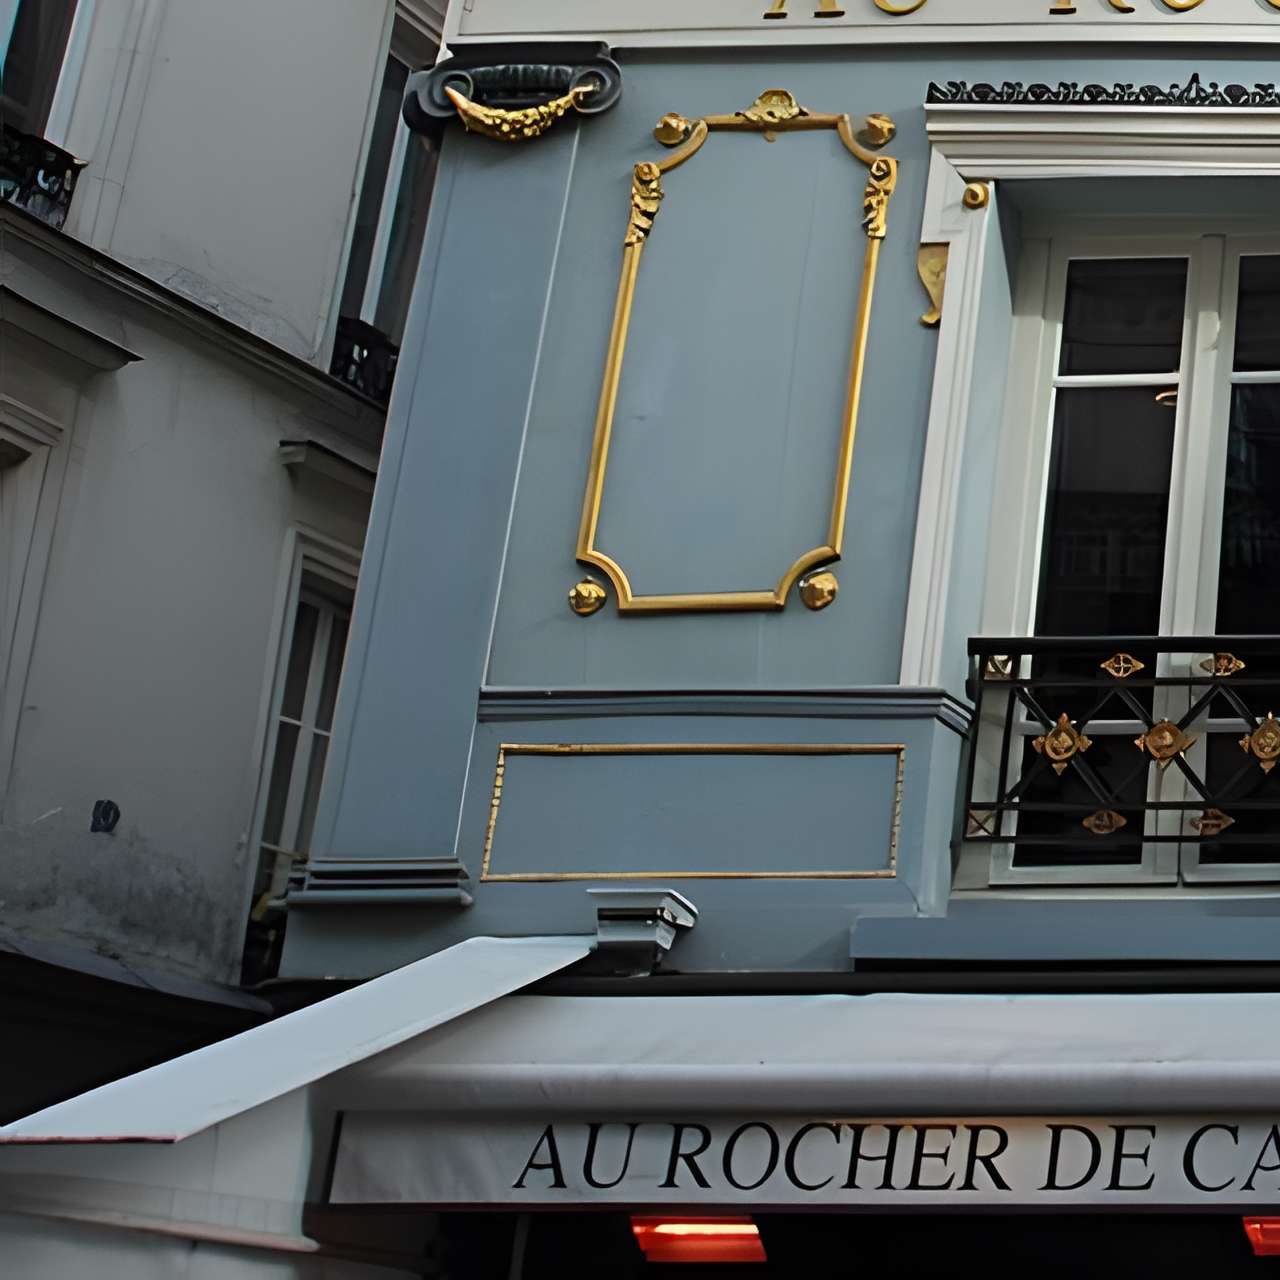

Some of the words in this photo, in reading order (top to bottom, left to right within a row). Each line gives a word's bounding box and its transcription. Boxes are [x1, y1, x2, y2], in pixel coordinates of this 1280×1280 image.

[512, 1122, 639, 1190] AU
[658, 1121, 1013, 1192] ROCHER
[1037, 1124, 1156, 1191] DE
